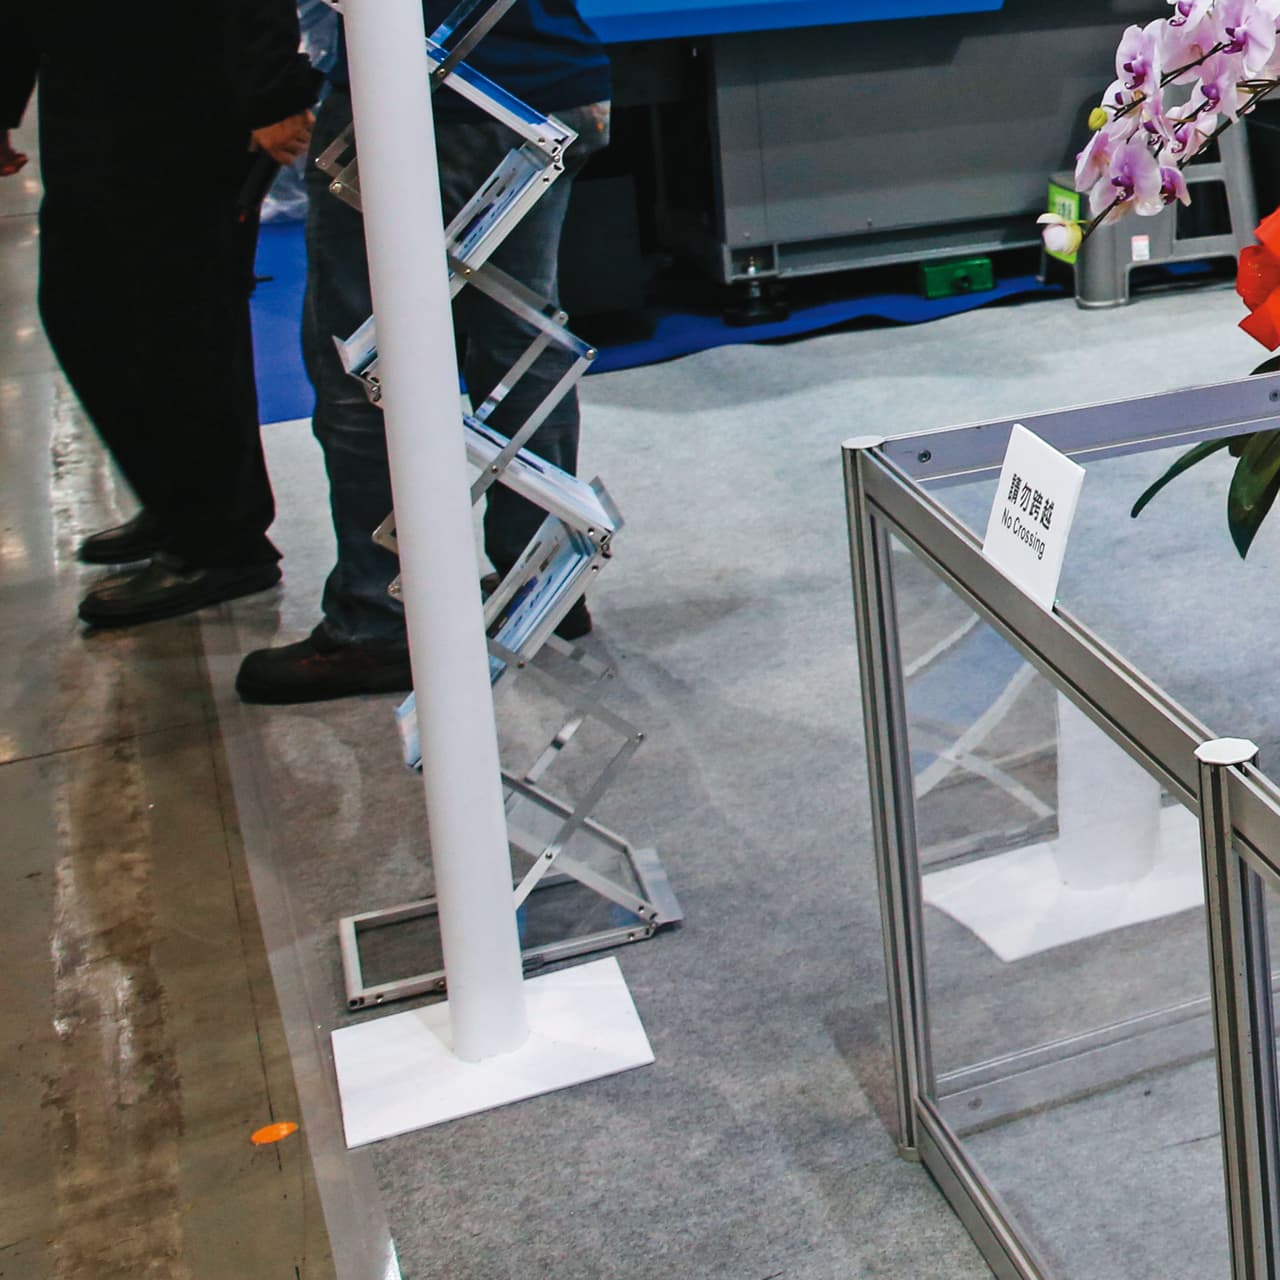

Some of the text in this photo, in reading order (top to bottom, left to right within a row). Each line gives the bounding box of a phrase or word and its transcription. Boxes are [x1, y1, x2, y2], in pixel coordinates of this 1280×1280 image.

[1006, 472, 1055, 531] 請勿跨越
[1001, 508, 1046, 560] No Crossing
